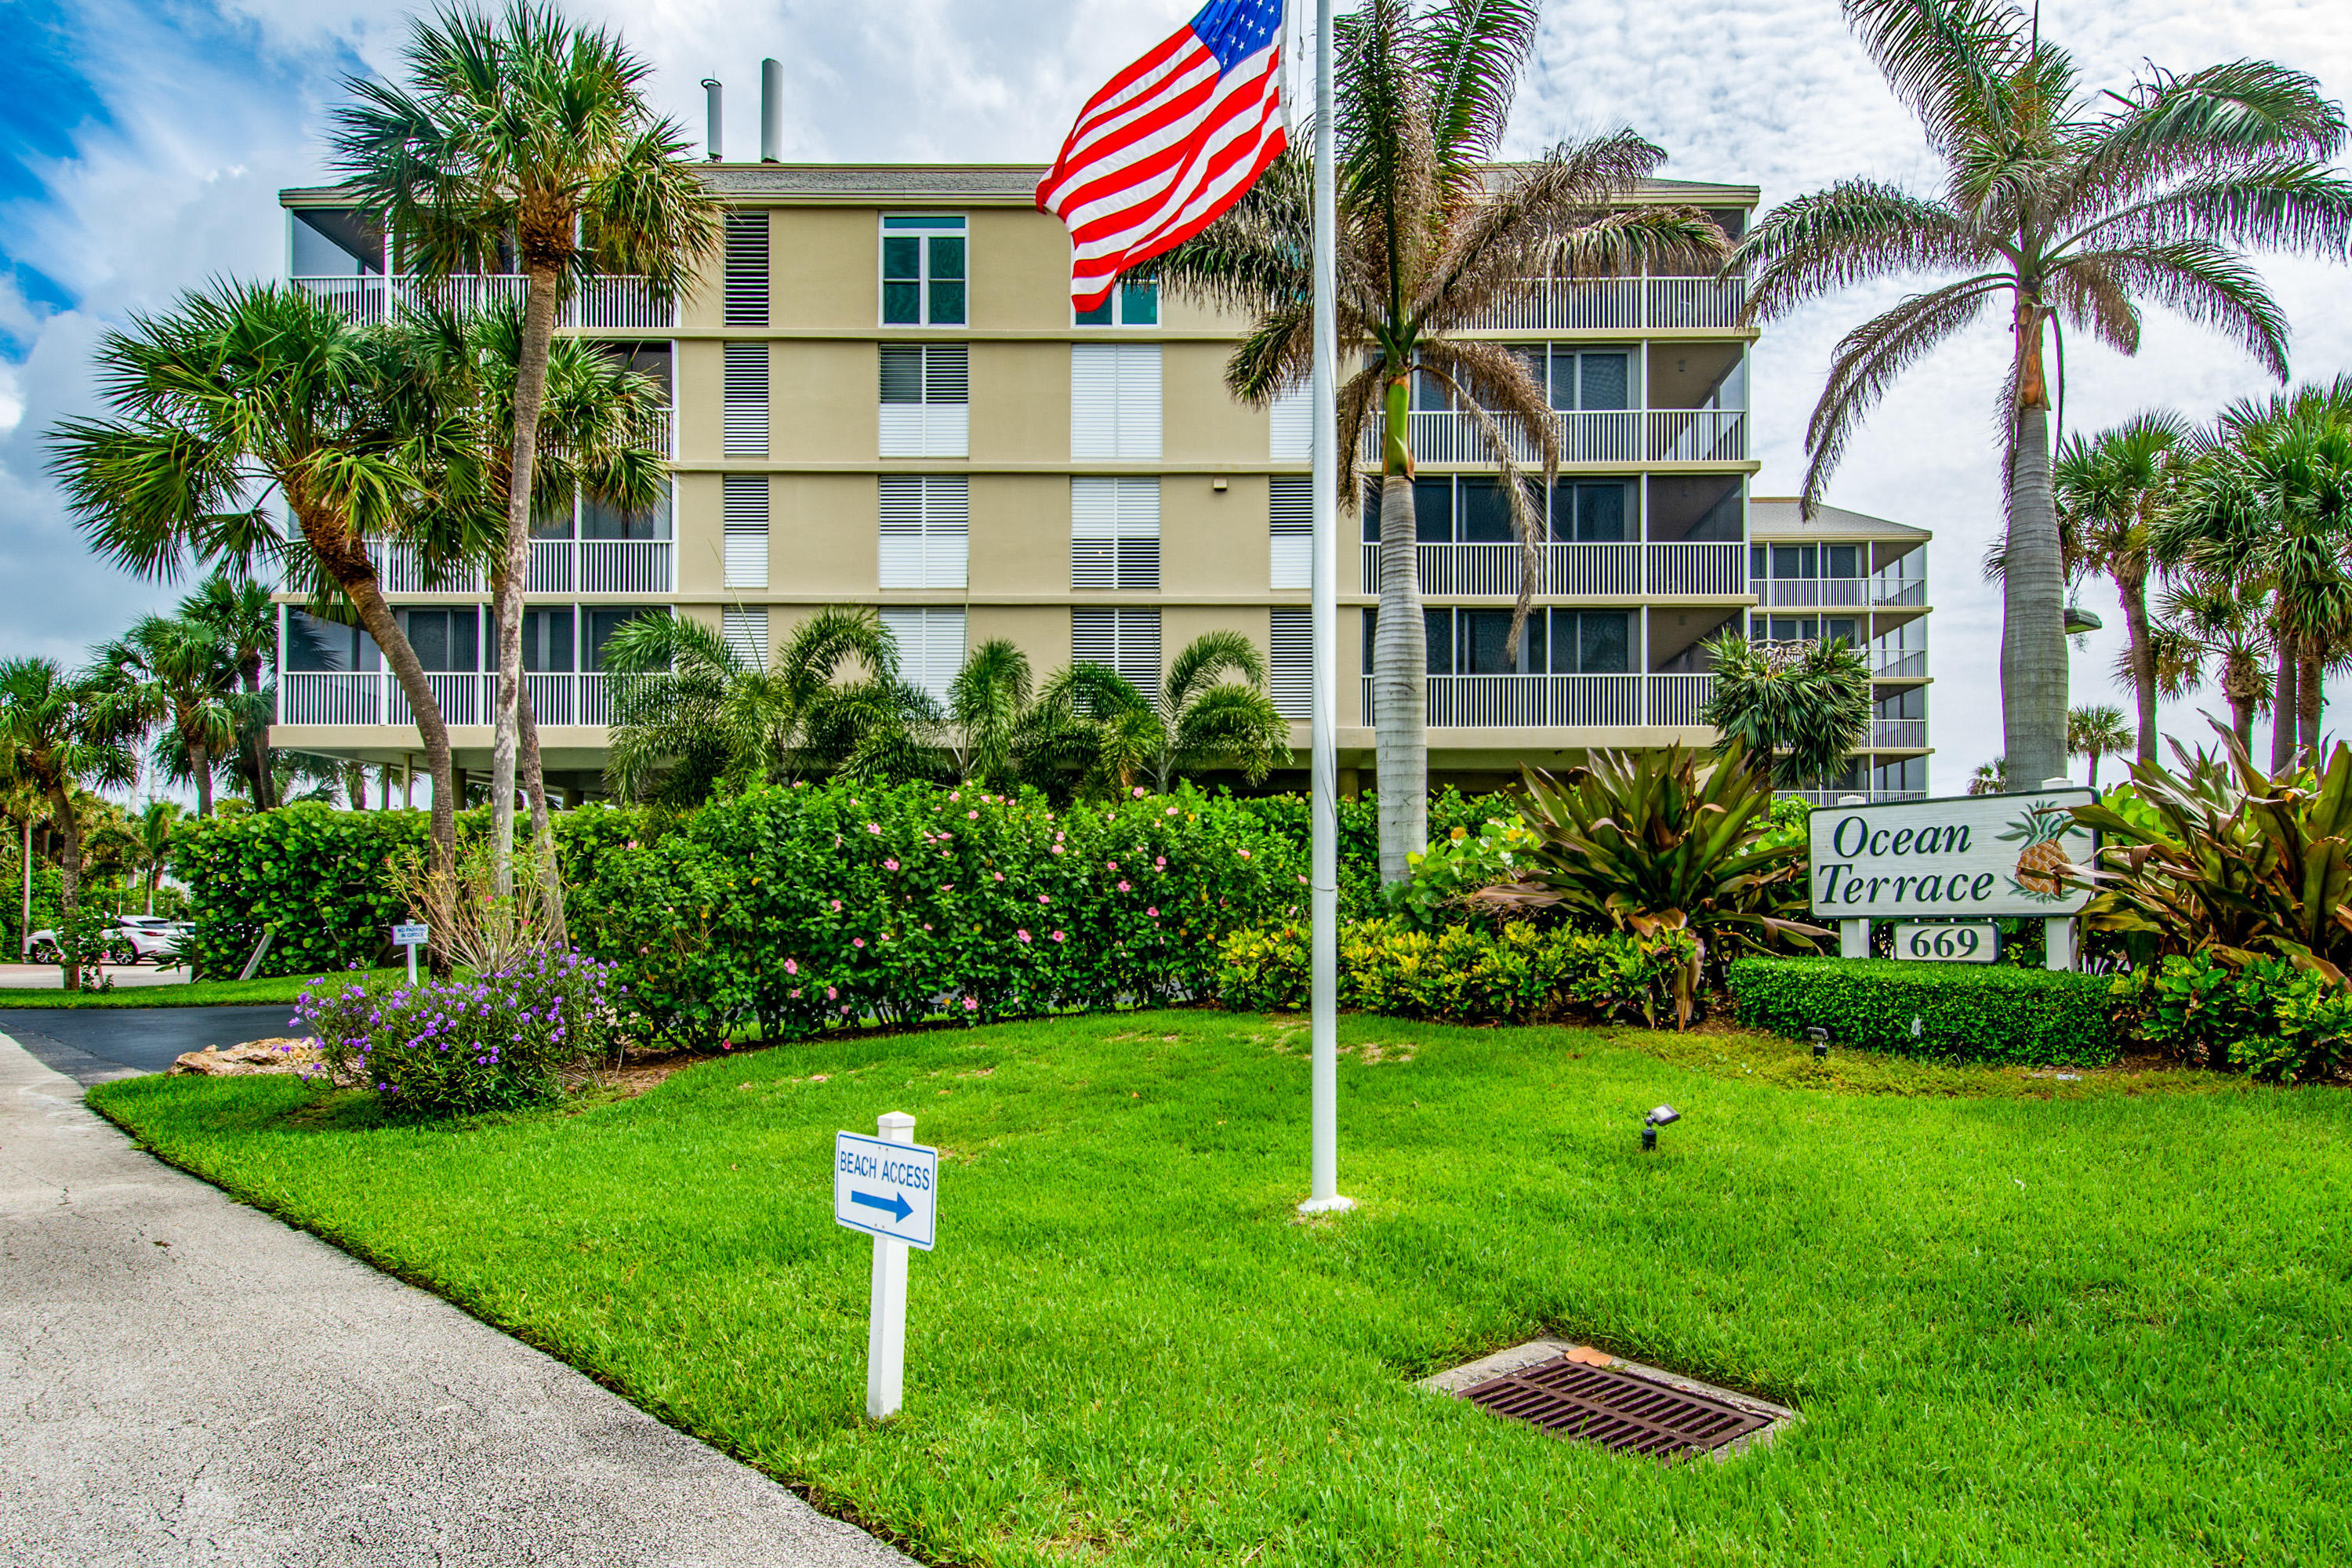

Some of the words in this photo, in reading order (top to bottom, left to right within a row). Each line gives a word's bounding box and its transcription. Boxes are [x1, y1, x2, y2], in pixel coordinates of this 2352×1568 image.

[1833, 816, 1972, 858] Ocean
[1818, 863, 1994, 904] Terrace
[1910, 928, 1979, 958] 669
[840, 1151, 877, 1179] BEACH
[881, 1160, 930, 1190] ACCESS
